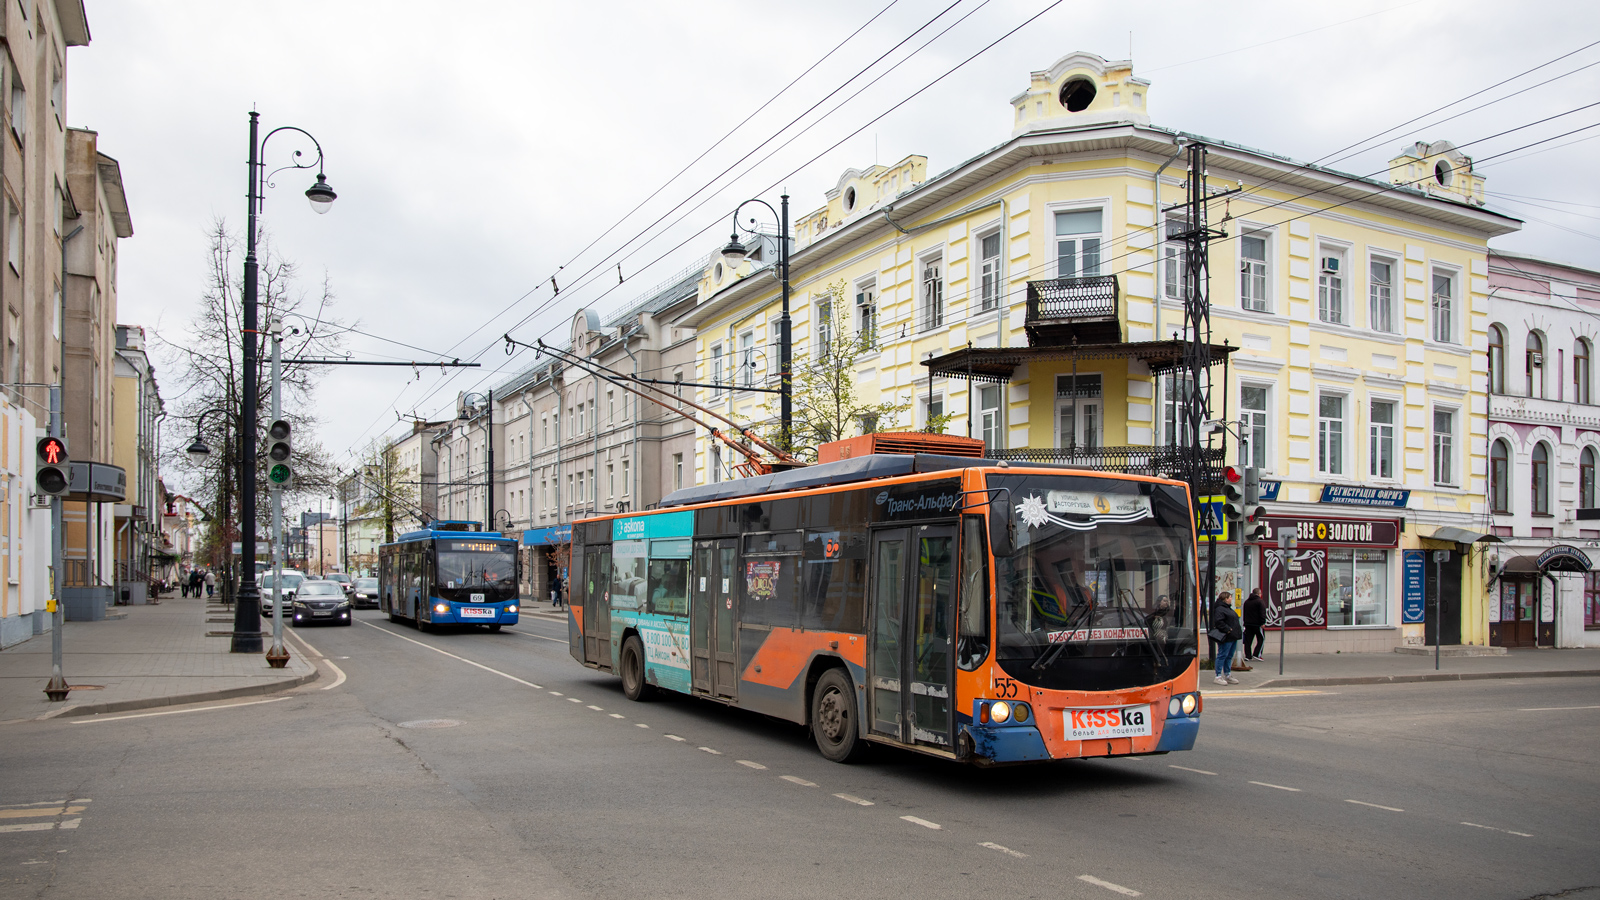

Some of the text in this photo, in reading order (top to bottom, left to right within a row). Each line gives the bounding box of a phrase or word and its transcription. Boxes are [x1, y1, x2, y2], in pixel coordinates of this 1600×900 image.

[1377, 489, 1403, 500] ФИРМЪ
[887, 492, 953, 516] Транс-Альфа
[1096, 494, 1106, 511] 4
[624, 518, 645, 533] askona
[1297, 521, 1315, 539] 585
[1328, 522, 1373, 542] ЗОЛОТОЙ
[1286, 586, 1310, 601] БРАСЛЕТЫ
[651, 632, 660, 645] 800
[661, 634, 672, 647] 100
[1048, 628, 1149, 643] РАБОТАЕТ БЕЗ КОНДУКТОРА
[994, 678, 1018, 698] 55
[1072, 729, 1095, 737] белье
[1112, 726, 1145, 735] поцелуев
